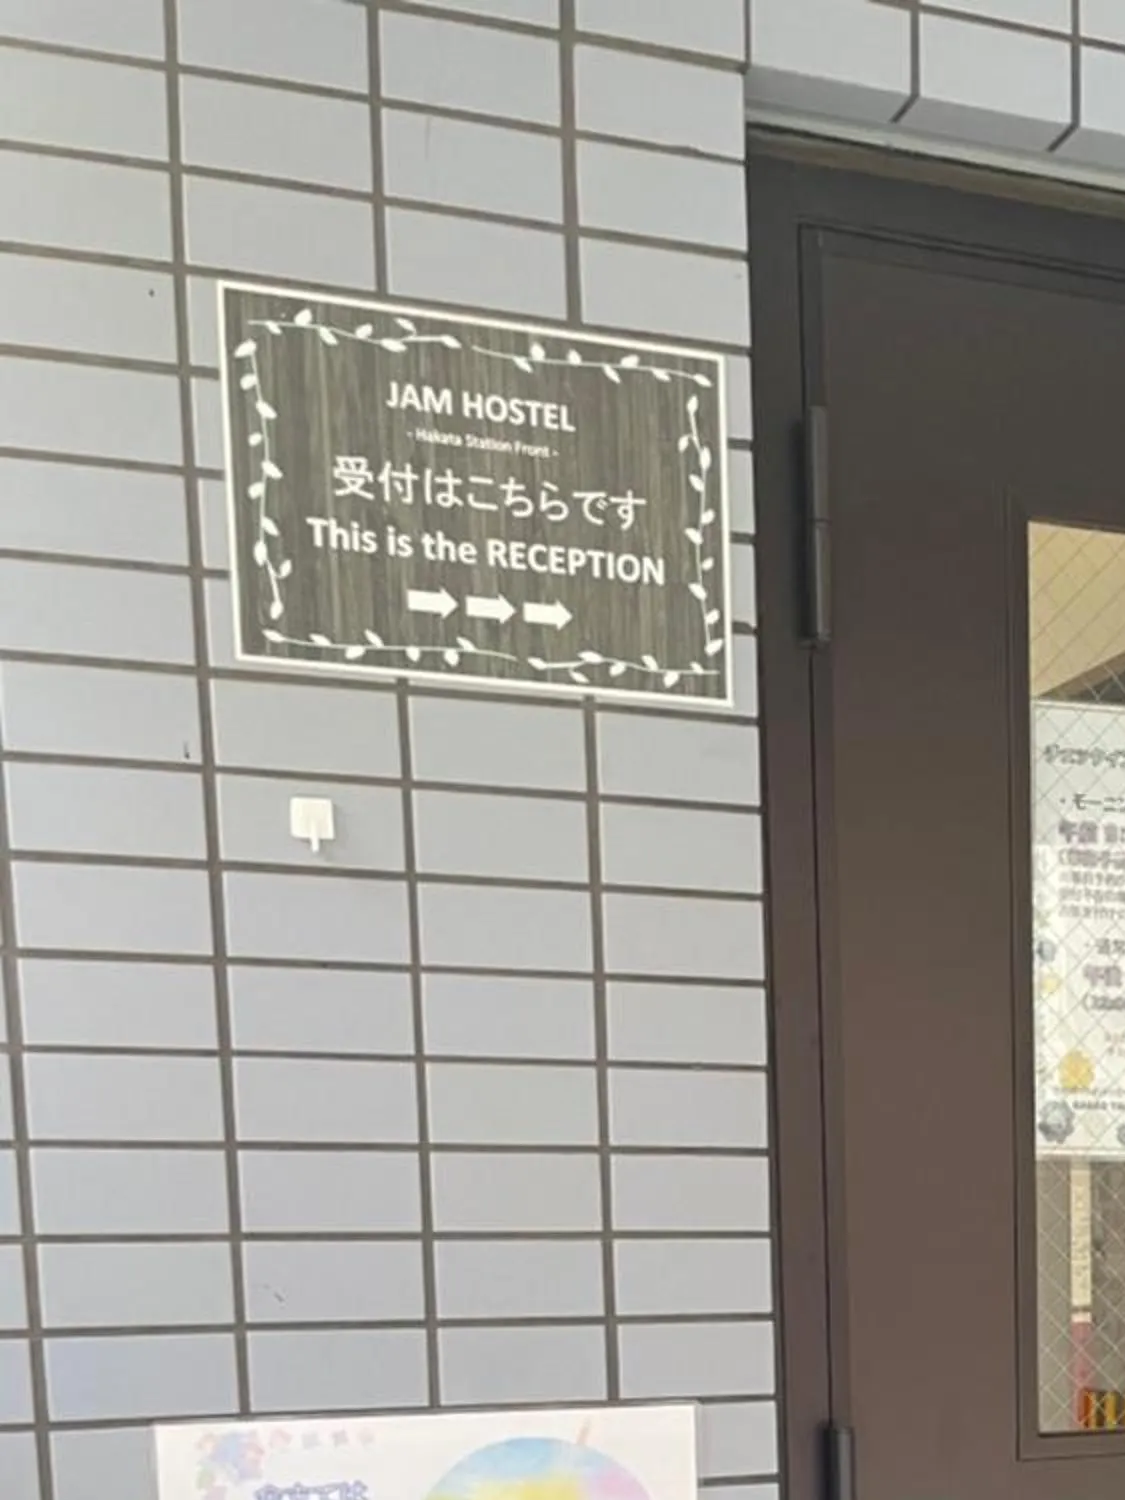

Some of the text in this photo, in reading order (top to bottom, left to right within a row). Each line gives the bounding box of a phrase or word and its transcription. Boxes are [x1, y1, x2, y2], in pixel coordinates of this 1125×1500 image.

[386, 380, 576, 432] JAM HOSTEL
[415, 428, 549, 458] Hakata Station Front
[332, 455, 648, 531] 受付はこちらです
[306, 516, 666, 587] This is the RECEPTION
